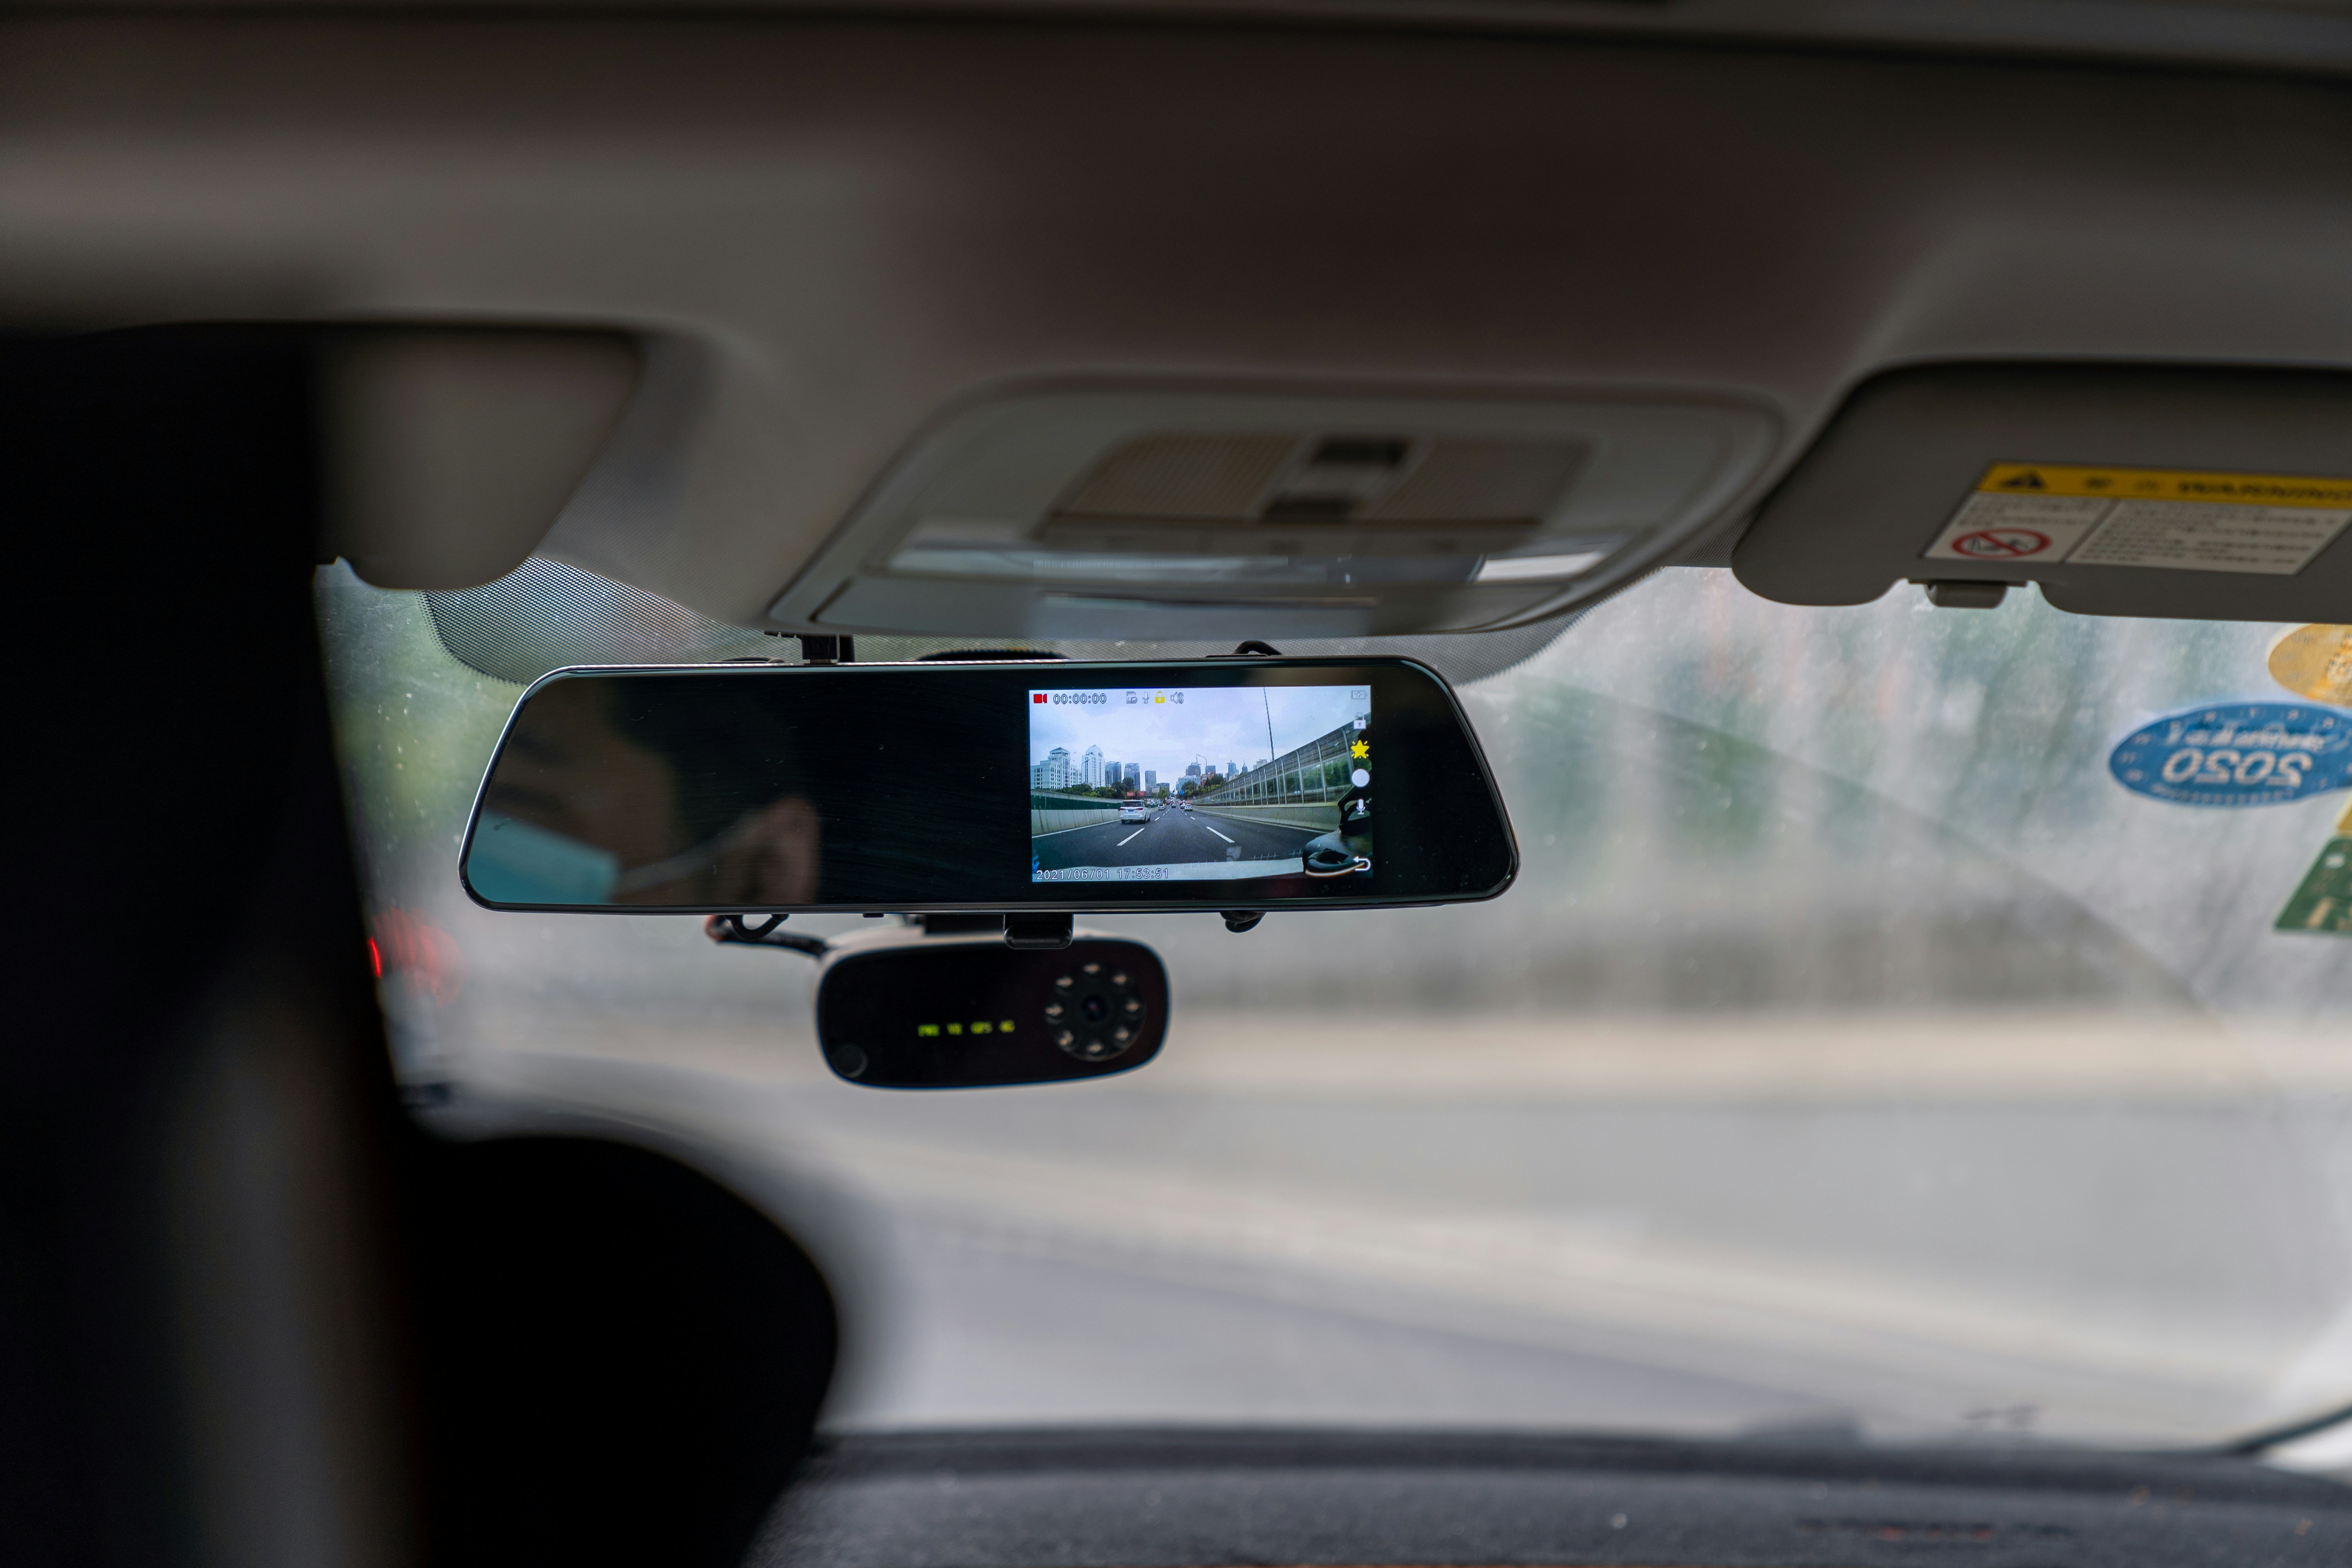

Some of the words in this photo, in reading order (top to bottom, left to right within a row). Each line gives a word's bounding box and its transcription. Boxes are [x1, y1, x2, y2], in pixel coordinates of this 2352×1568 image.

[1053, 693, 1107, 704] 00:00:00
[1036, 869, 1110, 880] 2021/06/01
[1117, 868, 1169, 879] 17:53:51
